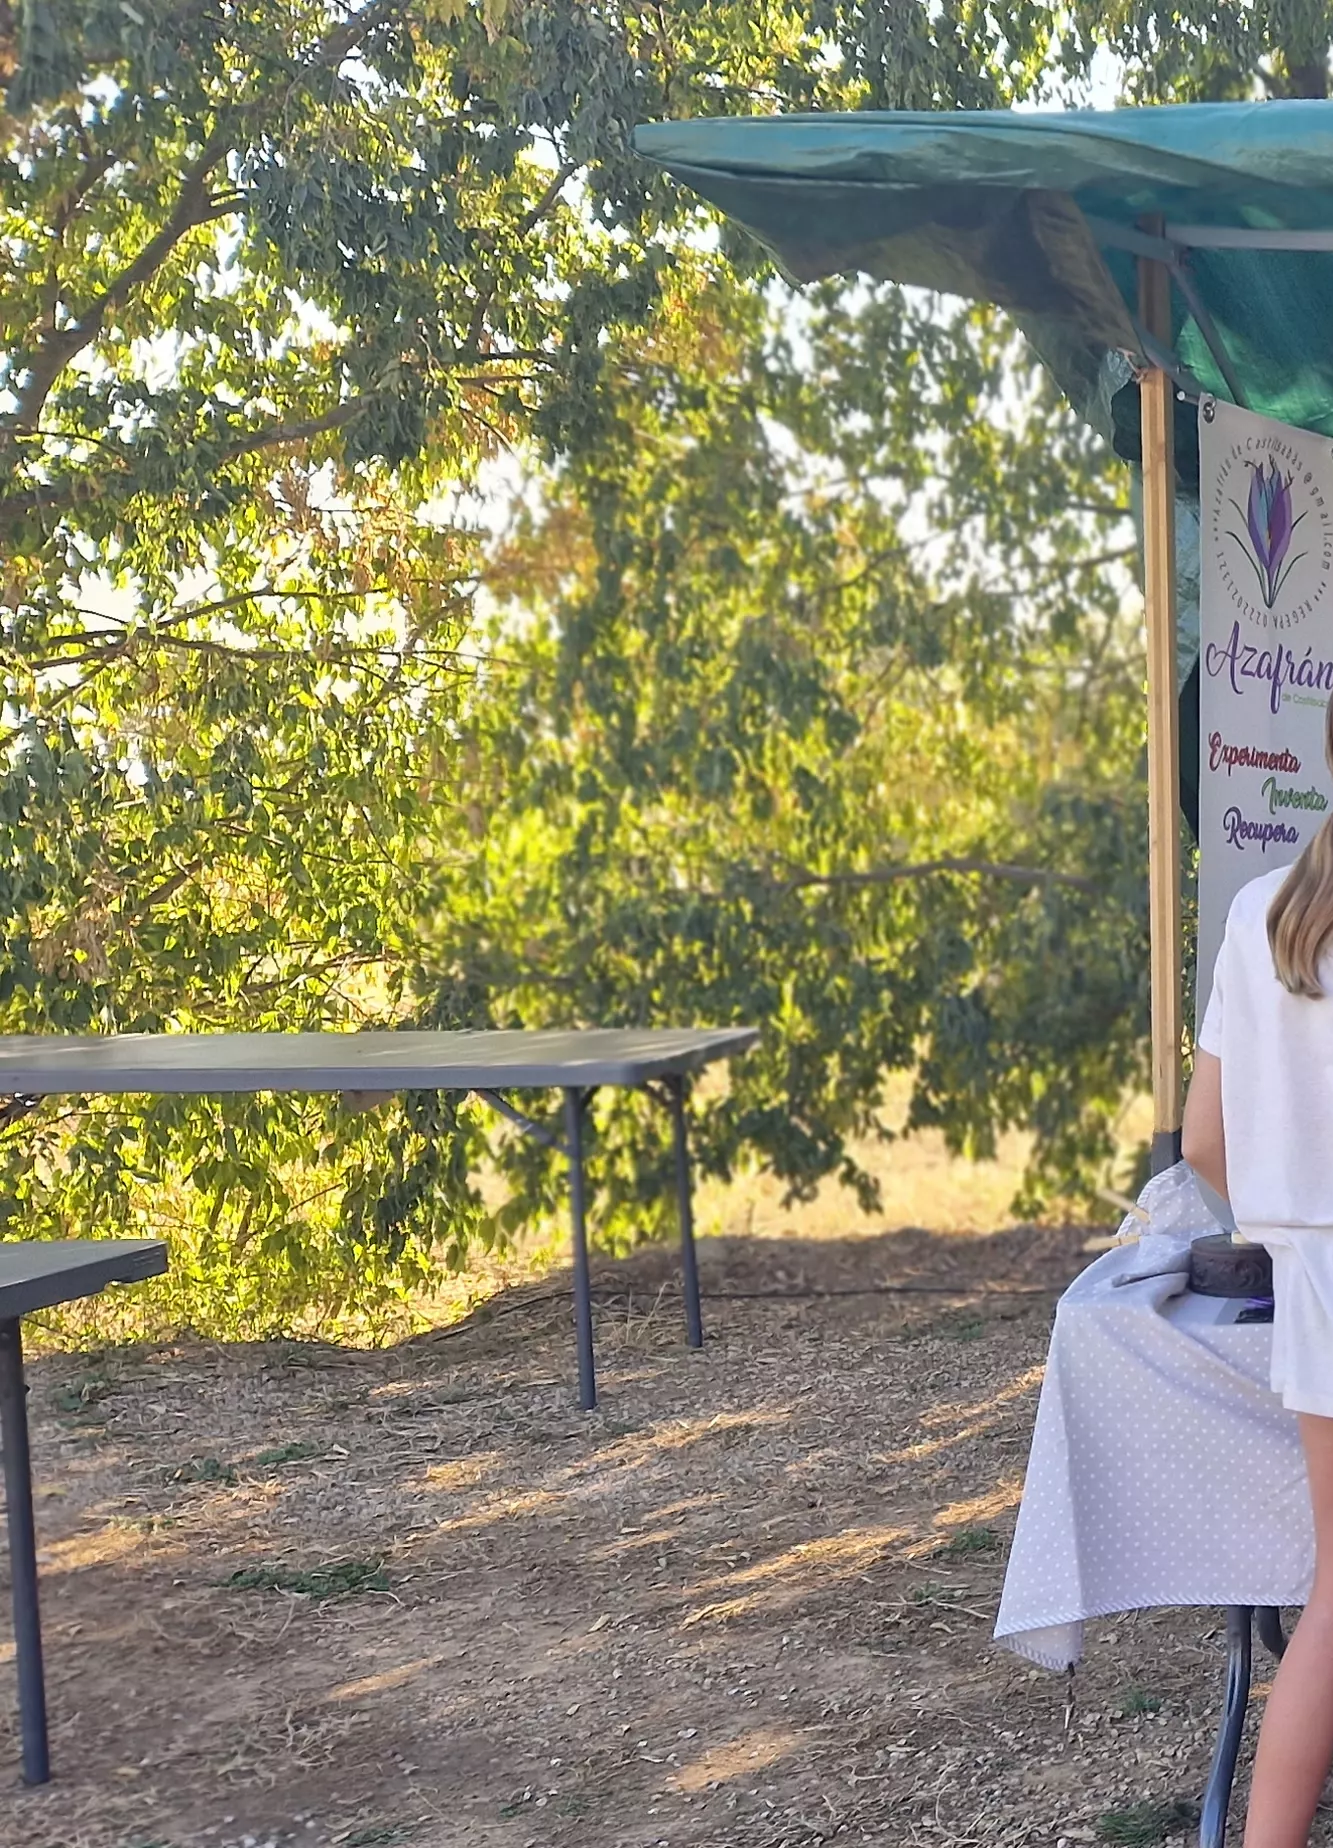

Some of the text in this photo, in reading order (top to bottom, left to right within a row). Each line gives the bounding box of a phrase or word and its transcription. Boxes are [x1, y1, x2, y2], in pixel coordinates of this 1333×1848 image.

[1272, 599, 1313, 630] REGEPA
[1208, 731, 1302, 777] Experimenta
[1261, 775, 1329, 815] Inventa
[1222, 805, 1300, 854] Recupera
